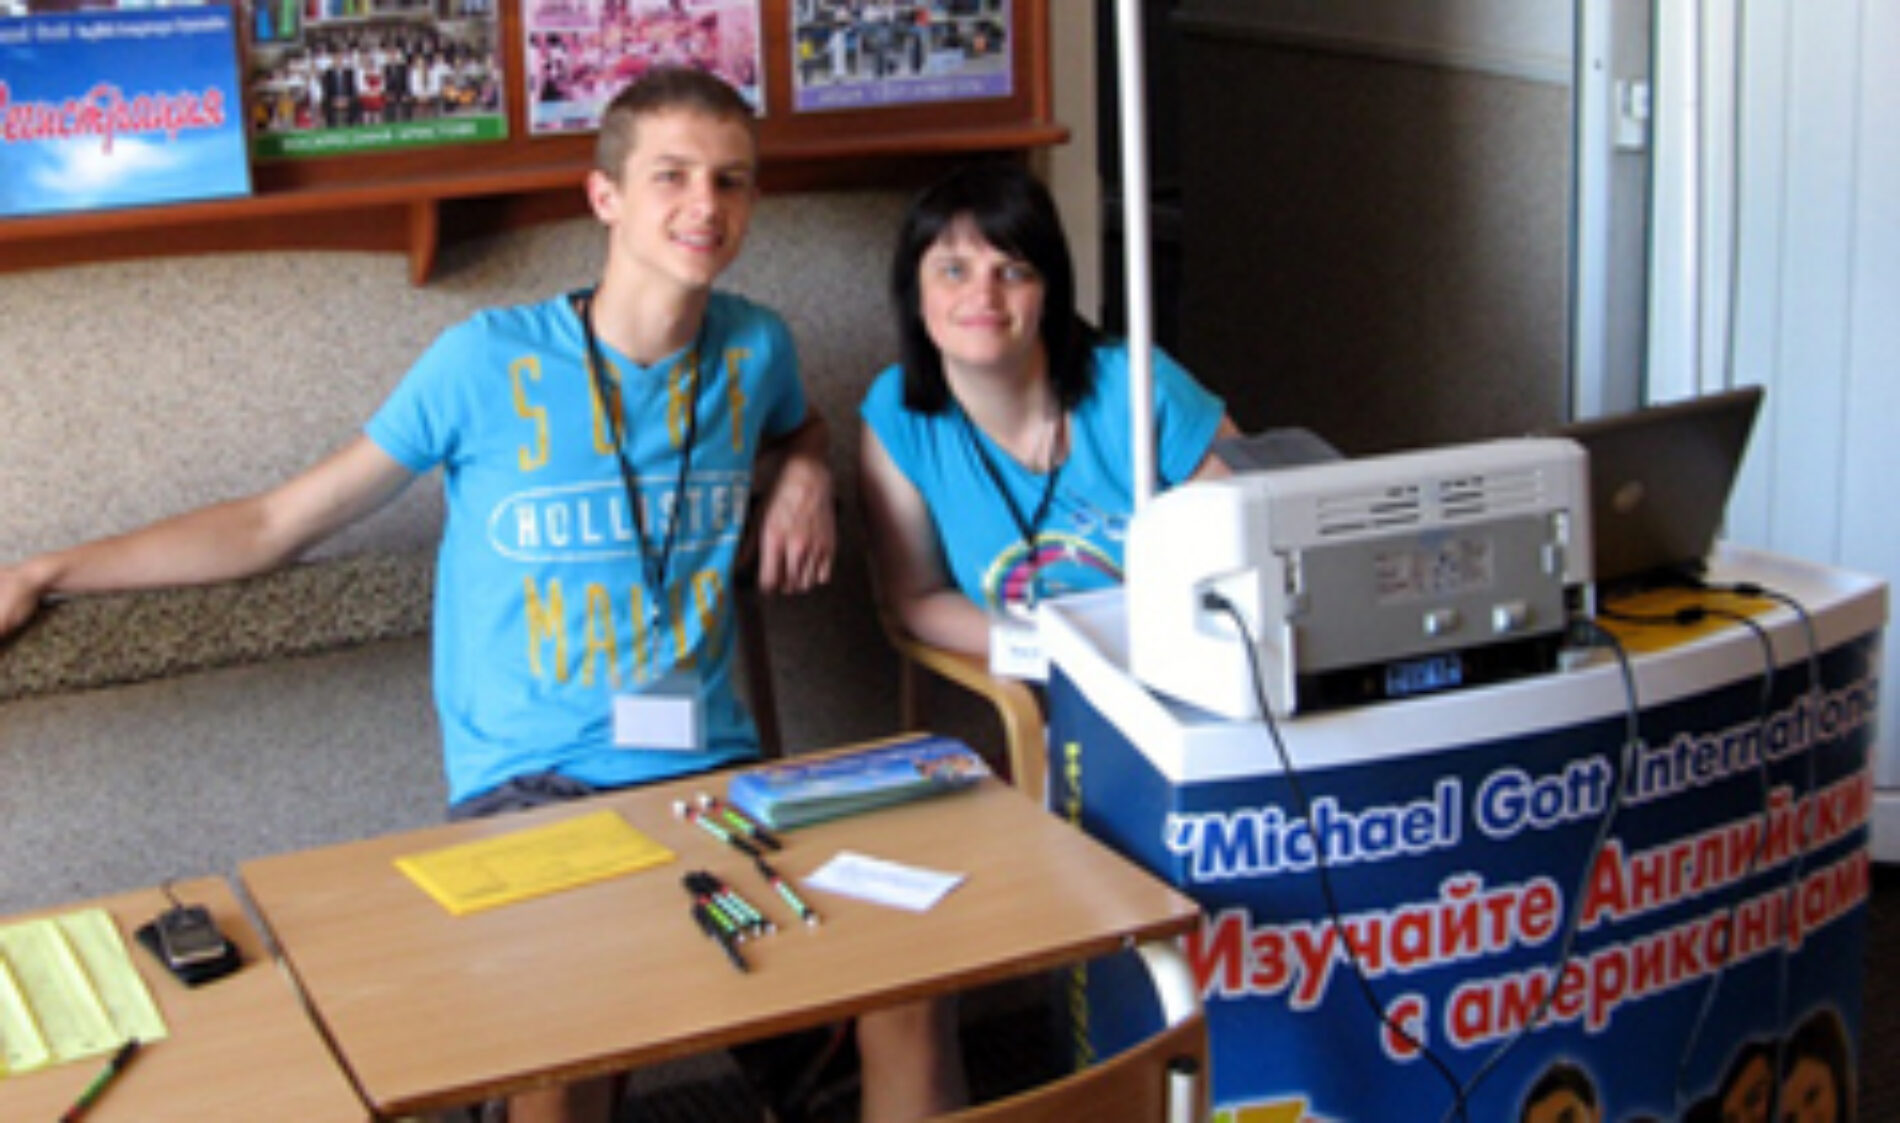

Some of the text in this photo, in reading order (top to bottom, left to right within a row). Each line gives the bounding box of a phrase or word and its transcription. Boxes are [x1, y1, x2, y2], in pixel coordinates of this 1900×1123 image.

[0, 79, 223, 155] егистрация
[1477, 760, 1612, 837] Gott
[1182, 873, 1560, 1010] Изучайте
